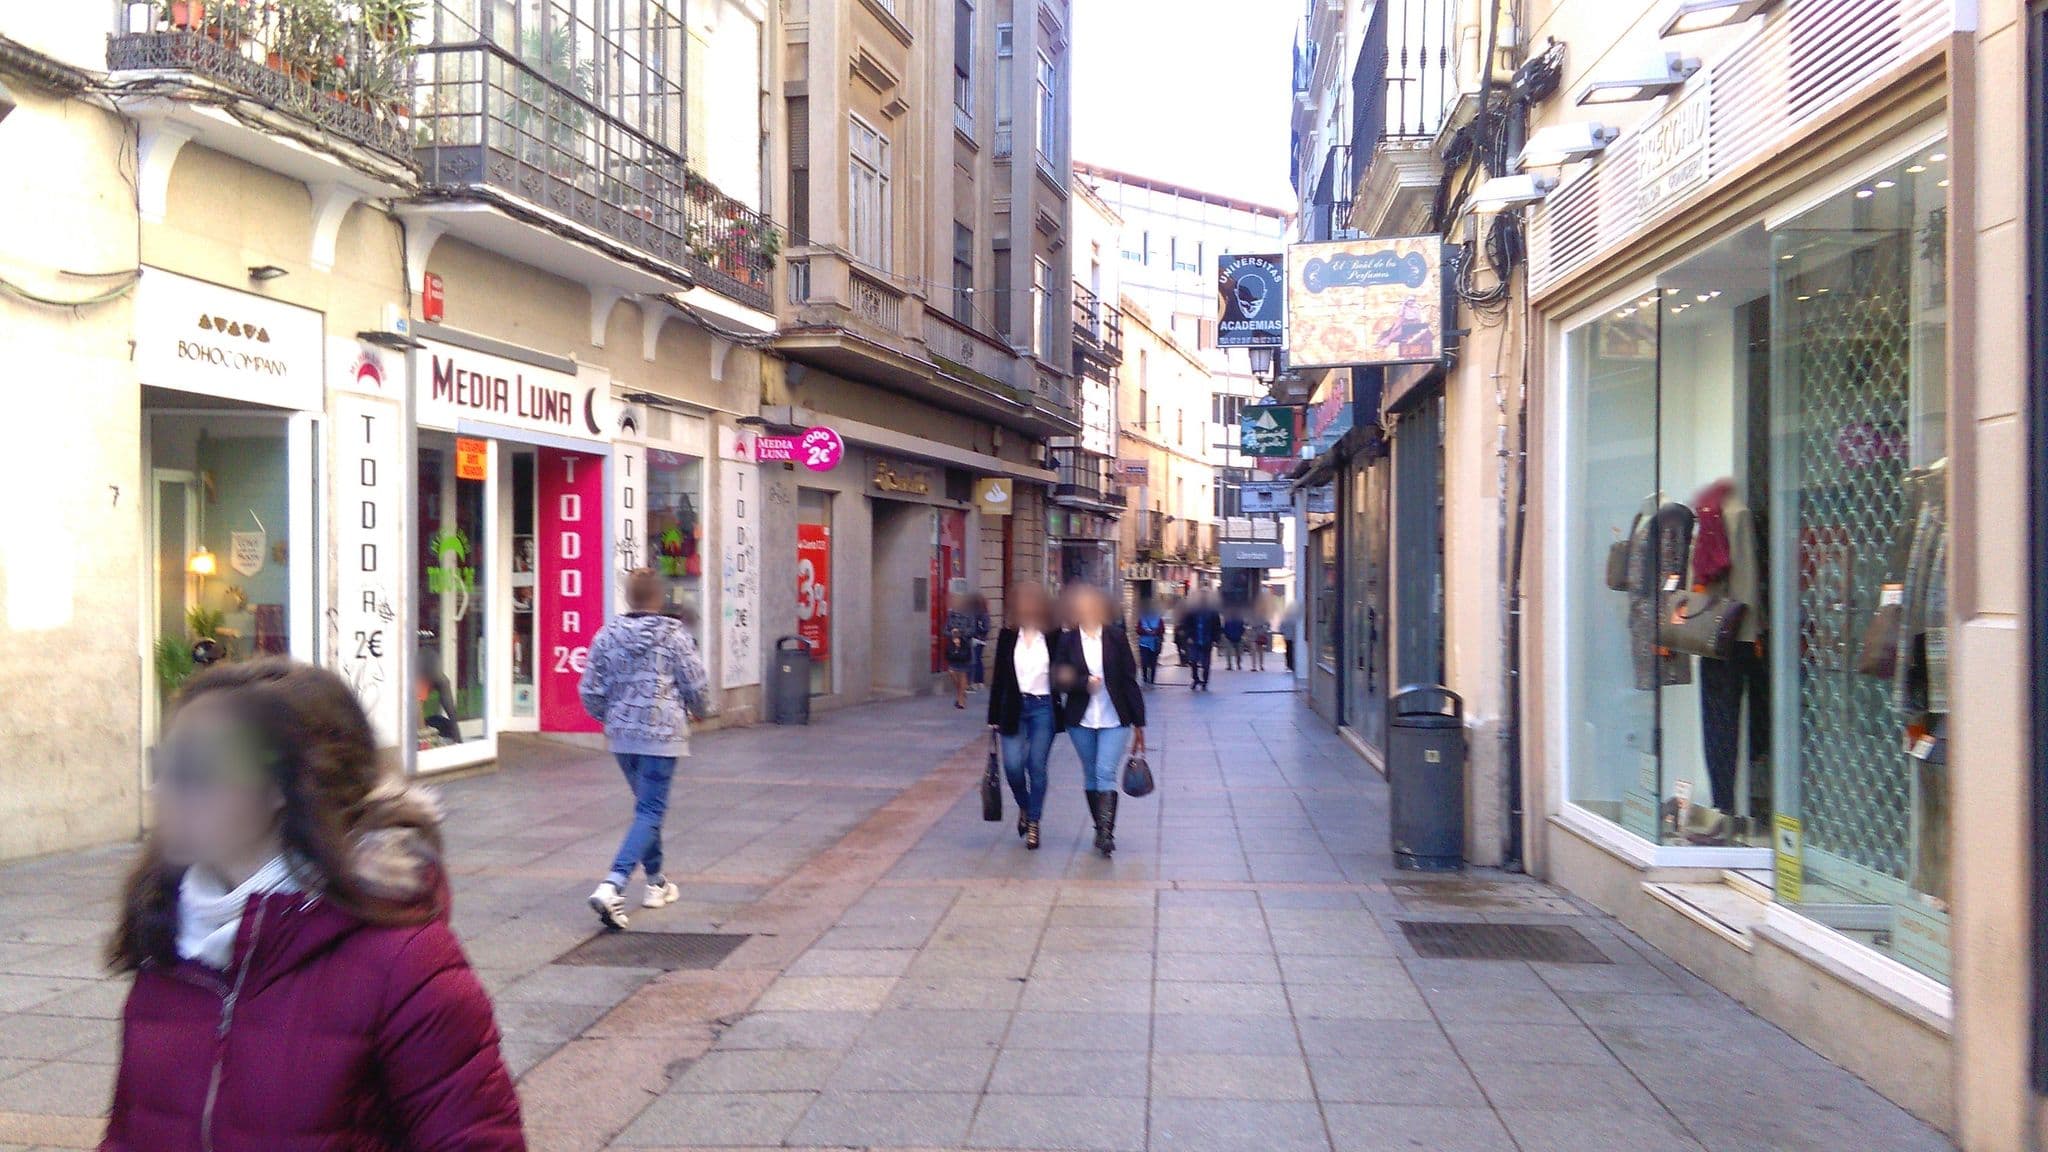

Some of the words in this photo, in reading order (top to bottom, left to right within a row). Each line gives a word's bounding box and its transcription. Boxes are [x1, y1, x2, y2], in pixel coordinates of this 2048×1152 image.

[1219, 257, 1282, 284] UNIVERSITAS
[1219, 320, 1282, 330] ACADEMIAS
[432, 354, 509, 414] MEDIA
[516, 373, 573, 425] LUNA
[758, 438, 794, 450] MEDIA
[802, 430, 830, 449] TODO
[760, 448, 791, 460] LUNA
[806, 446, 831, 466] 2€
[360, 414, 377, 572] TODO
[560, 456, 582, 598] TODO
[363, 590, 376, 613] A
[562, 611, 581, 634] A
[354, 630, 384, 659] 2€
